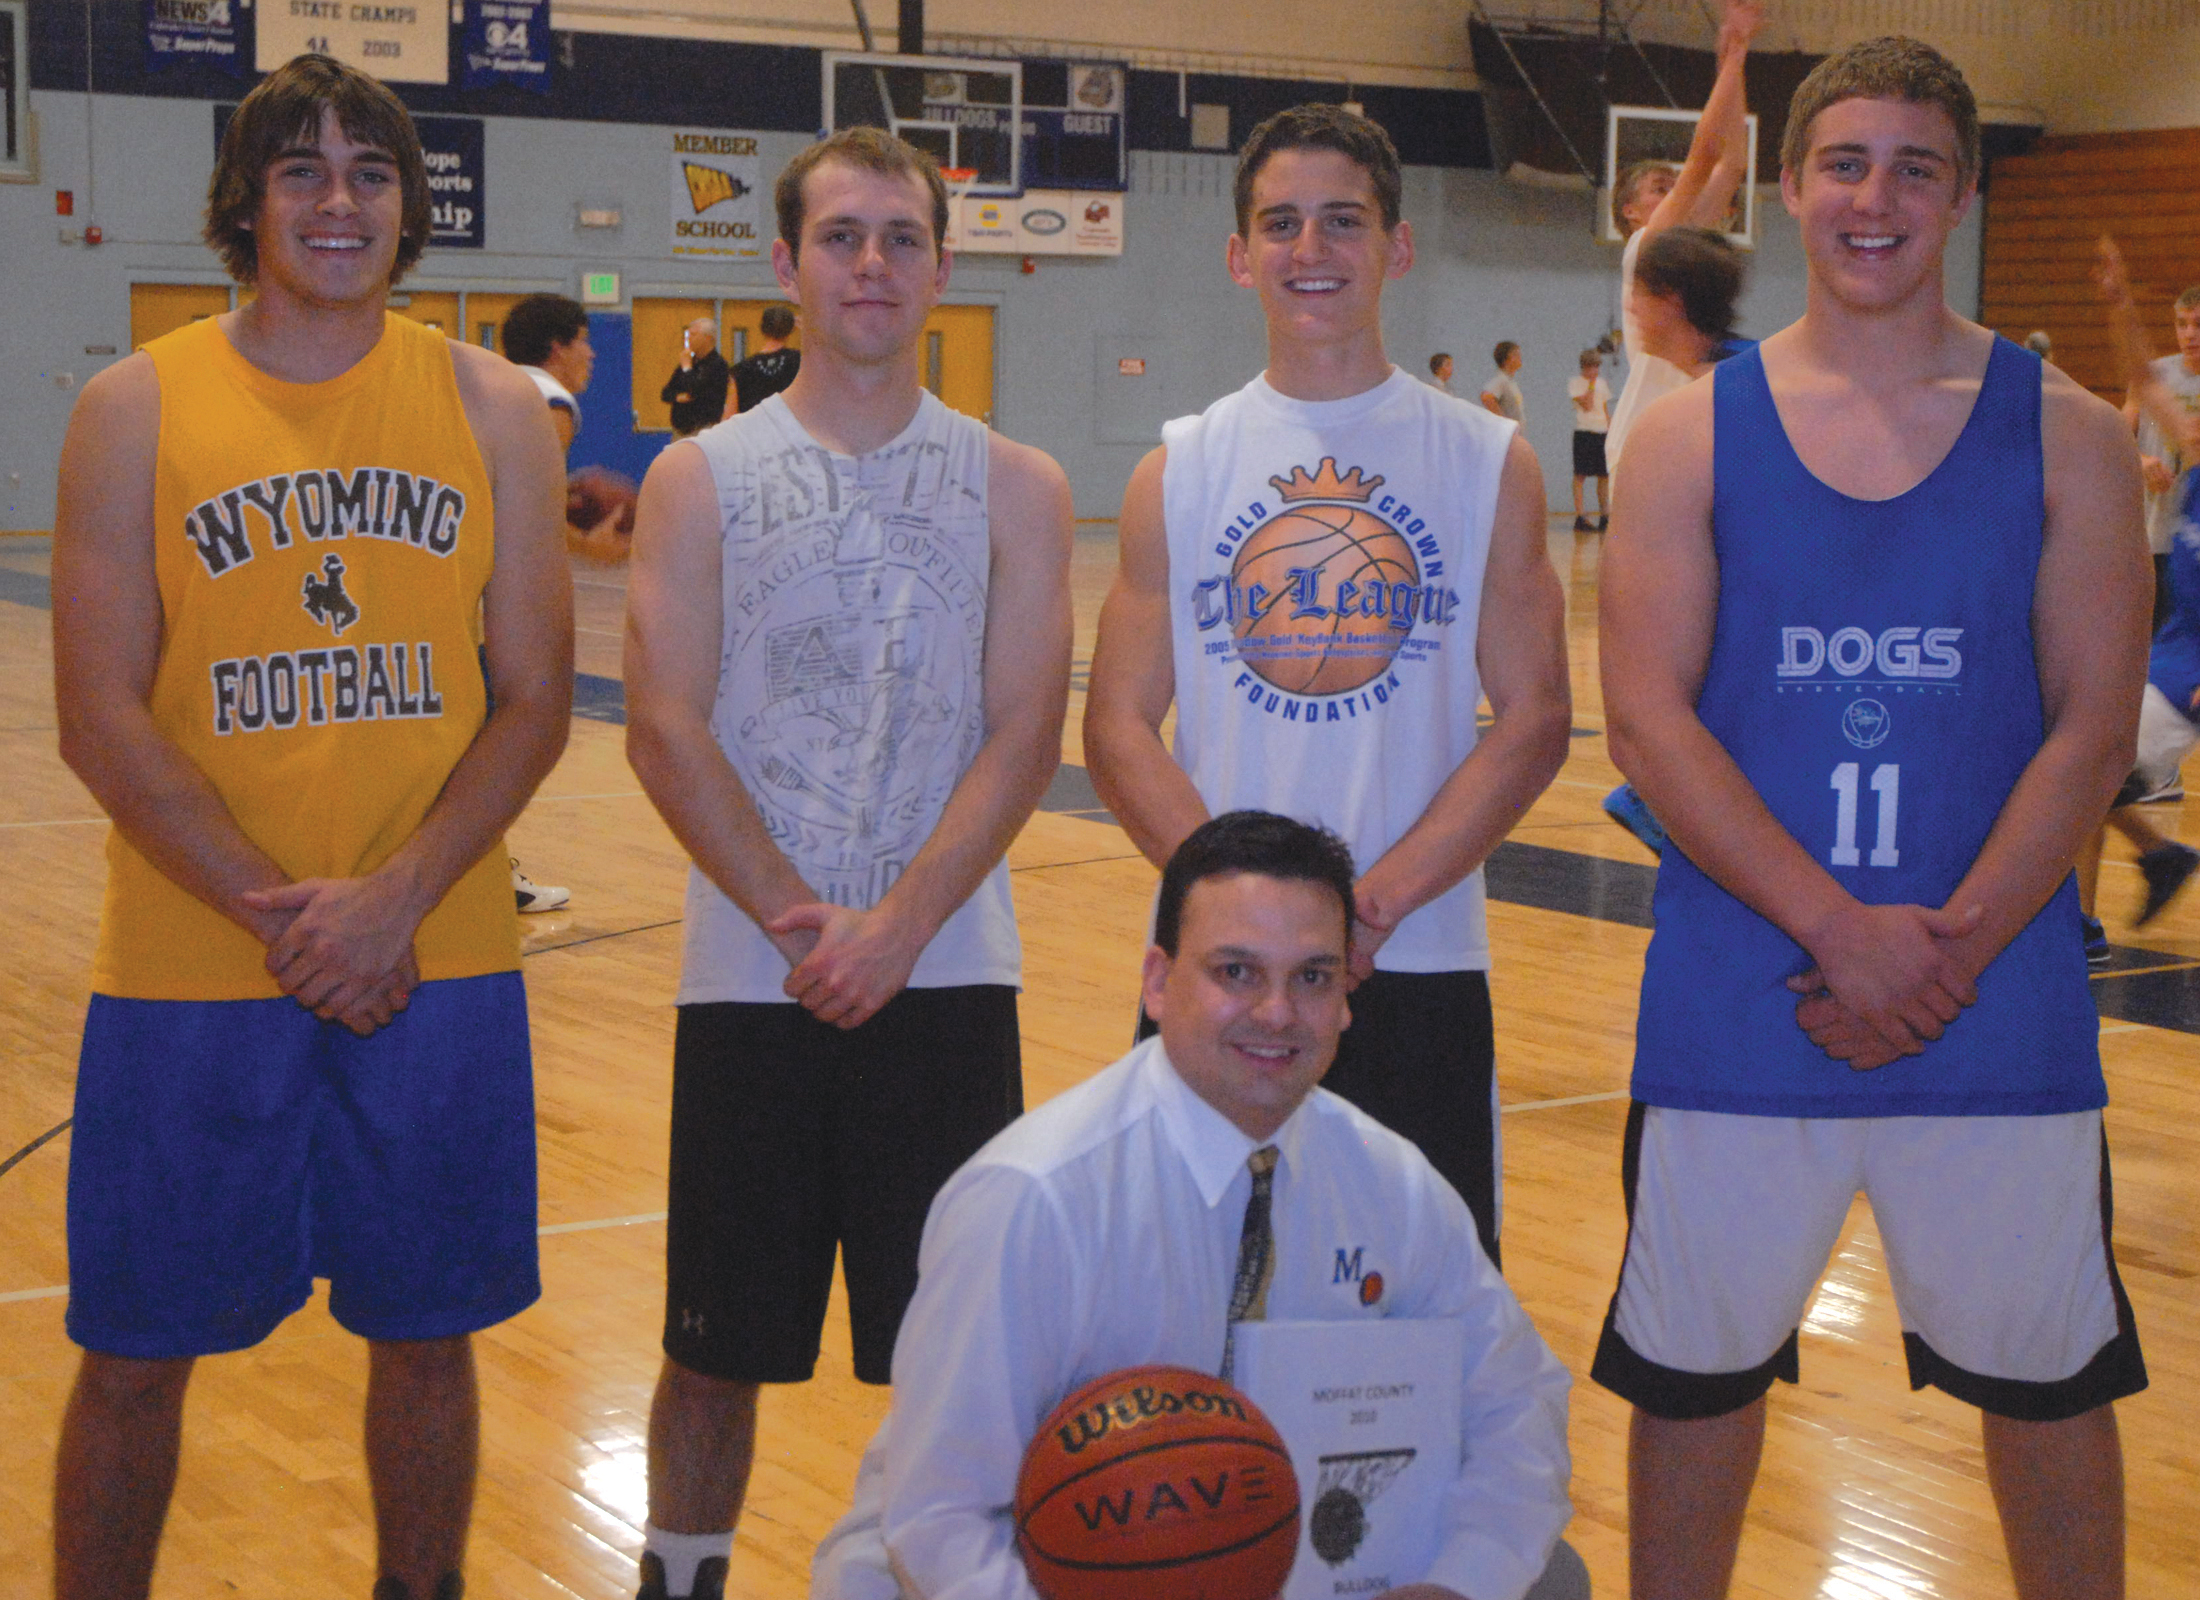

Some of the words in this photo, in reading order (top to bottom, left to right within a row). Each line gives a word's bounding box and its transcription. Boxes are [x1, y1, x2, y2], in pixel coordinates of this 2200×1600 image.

[290, 0, 341, 20] STATE
[351, 5, 416, 24] CHAMPS
[674, 132, 758, 156] MEMBER
[676, 220, 756, 239] SCHOOL
[185, 466, 467, 579] WYOMING
[1215, 501, 1268, 558] GOLD
[1377, 494, 1444, 579] CROWN
[738, 539, 833, 617] EAGLE
[1286, 565, 1461, 630] League
[1776, 626, 1965, 679] DOGS
[210, 642, 443, 736] FOOTBALL
[1234, 671, 1401, 723] FOUNDATION
[1830, 762, 1900, 867] 11
[1333, 1246, 1365, 1285] M
[1057, 1386, 1248, 1454] Wilson
[1365, 1384, 1415, 1401] COUNTY
[1074, 1466, 1273, 1531] WAVE
